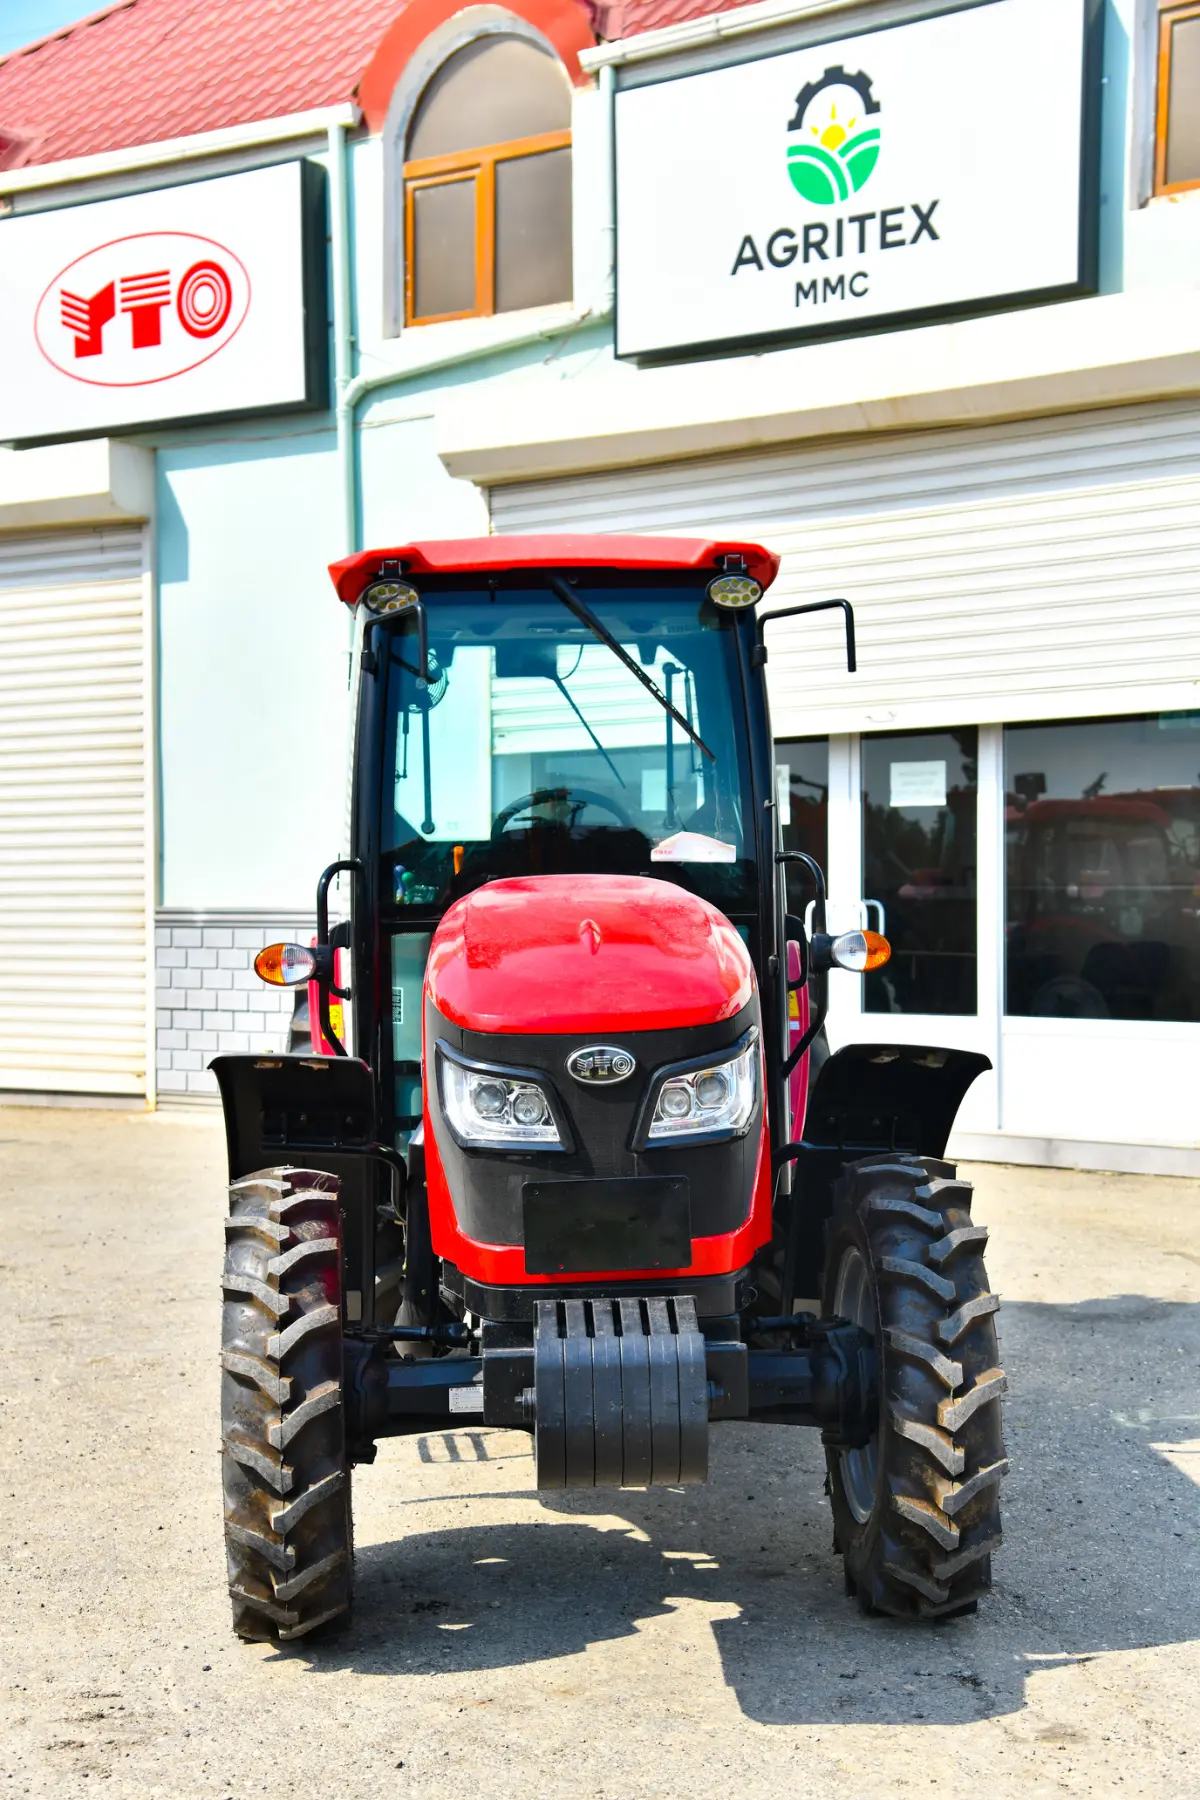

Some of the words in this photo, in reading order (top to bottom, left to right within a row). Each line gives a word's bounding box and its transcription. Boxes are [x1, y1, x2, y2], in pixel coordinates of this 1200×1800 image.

[730, 199, 940, 276] AGRITEX
[61, 259, 233, 359] YTO
[795, 271, 870, 308] MMC
[576, 1054, 631, 1077] YTO
